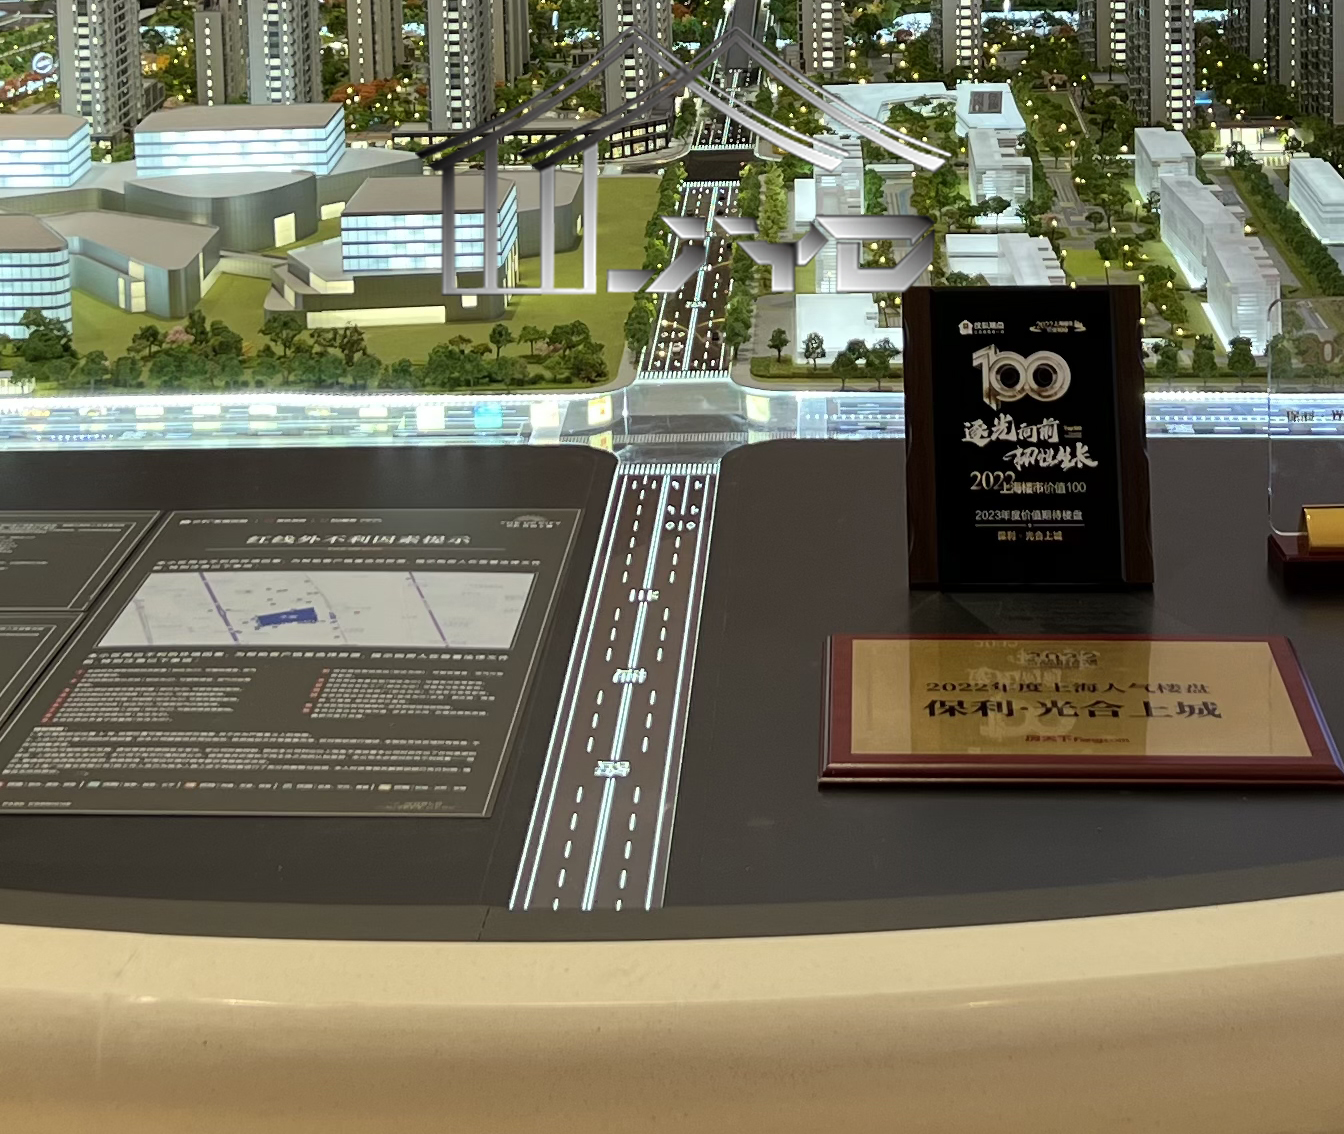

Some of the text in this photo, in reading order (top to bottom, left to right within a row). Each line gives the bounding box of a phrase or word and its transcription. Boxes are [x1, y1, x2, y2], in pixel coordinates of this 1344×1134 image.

[972, 343, 1071, 411] 100
[961, 412, 1060, 447] 逐光向前
[969, 470, 1016, 490] 2022
